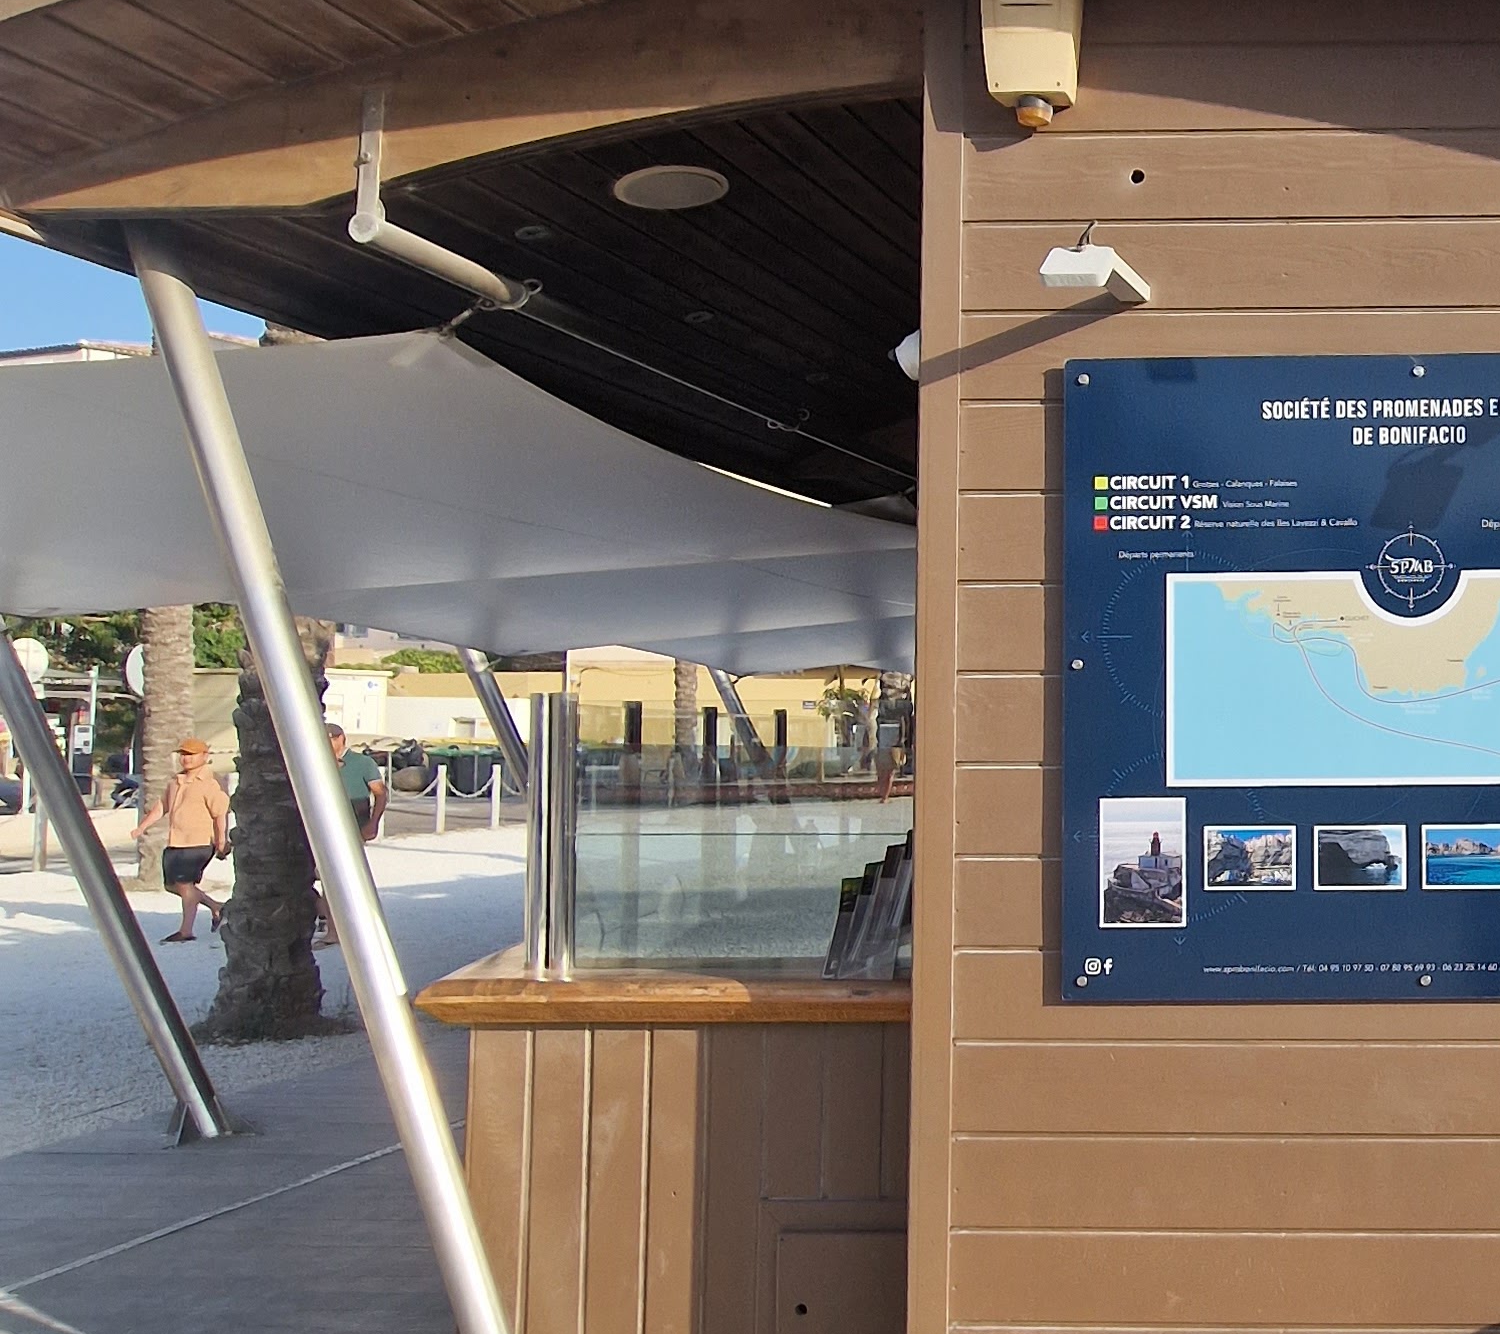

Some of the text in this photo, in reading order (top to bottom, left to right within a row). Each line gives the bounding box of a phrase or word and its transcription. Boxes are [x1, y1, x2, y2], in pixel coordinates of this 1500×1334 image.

[1262, 397, 1330, 419] SOCIÉTÉ
[1335, 400, 1367, 418] DES
[1372, 398, 1484, 418] PROMENADES
[1352, 426, 1467, 445] DE BONIFACIO
[1109, 475, 1189, 490] CIRCUIT 1
[1109, 494, 1218, 510] CIRCUIT VSM
[1109, 514, 1192, 530] CIRCUIT 2
[1260, 518, 1275, 527] des
[1328, 517, 1358, 527] Cavallo
[1342, 964, 1351, 972] 10
